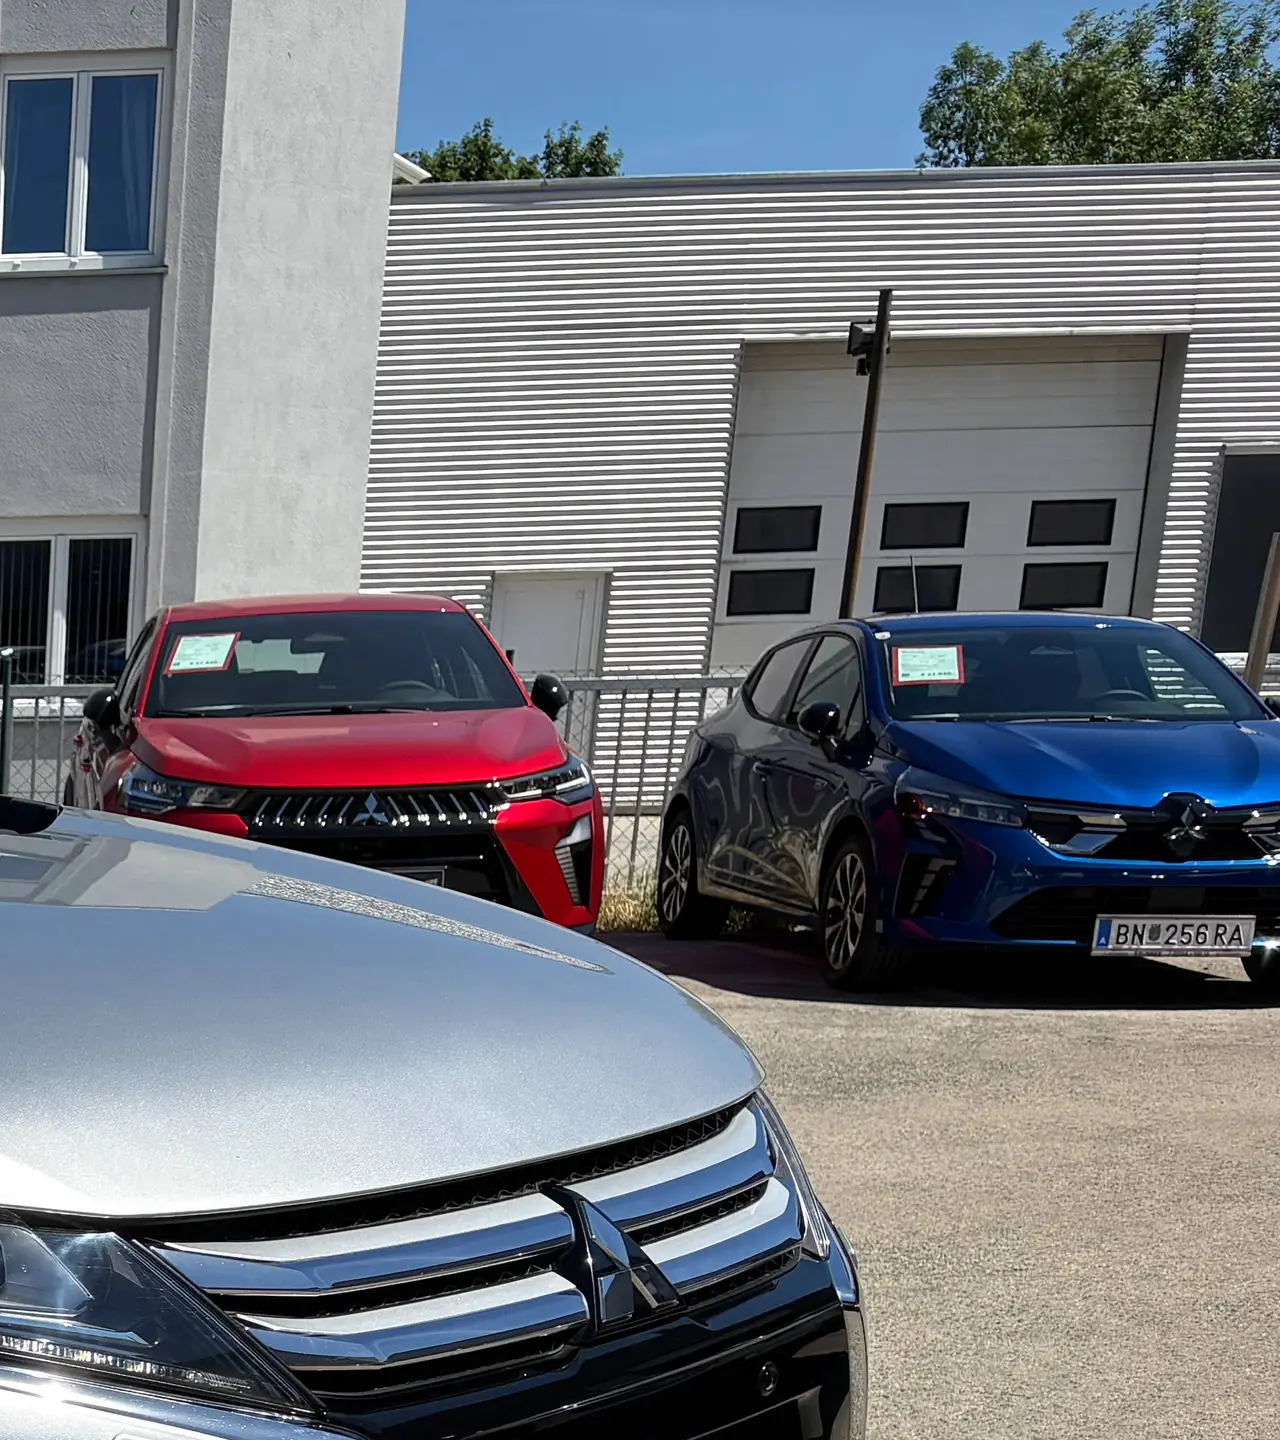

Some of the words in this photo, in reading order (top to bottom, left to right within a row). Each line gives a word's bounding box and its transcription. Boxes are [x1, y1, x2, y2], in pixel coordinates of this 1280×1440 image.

[1115, 923, 1146, 945] BN
[1164, 923, 1208, 945] 256
[1213, 923, 1244, 945] RA
